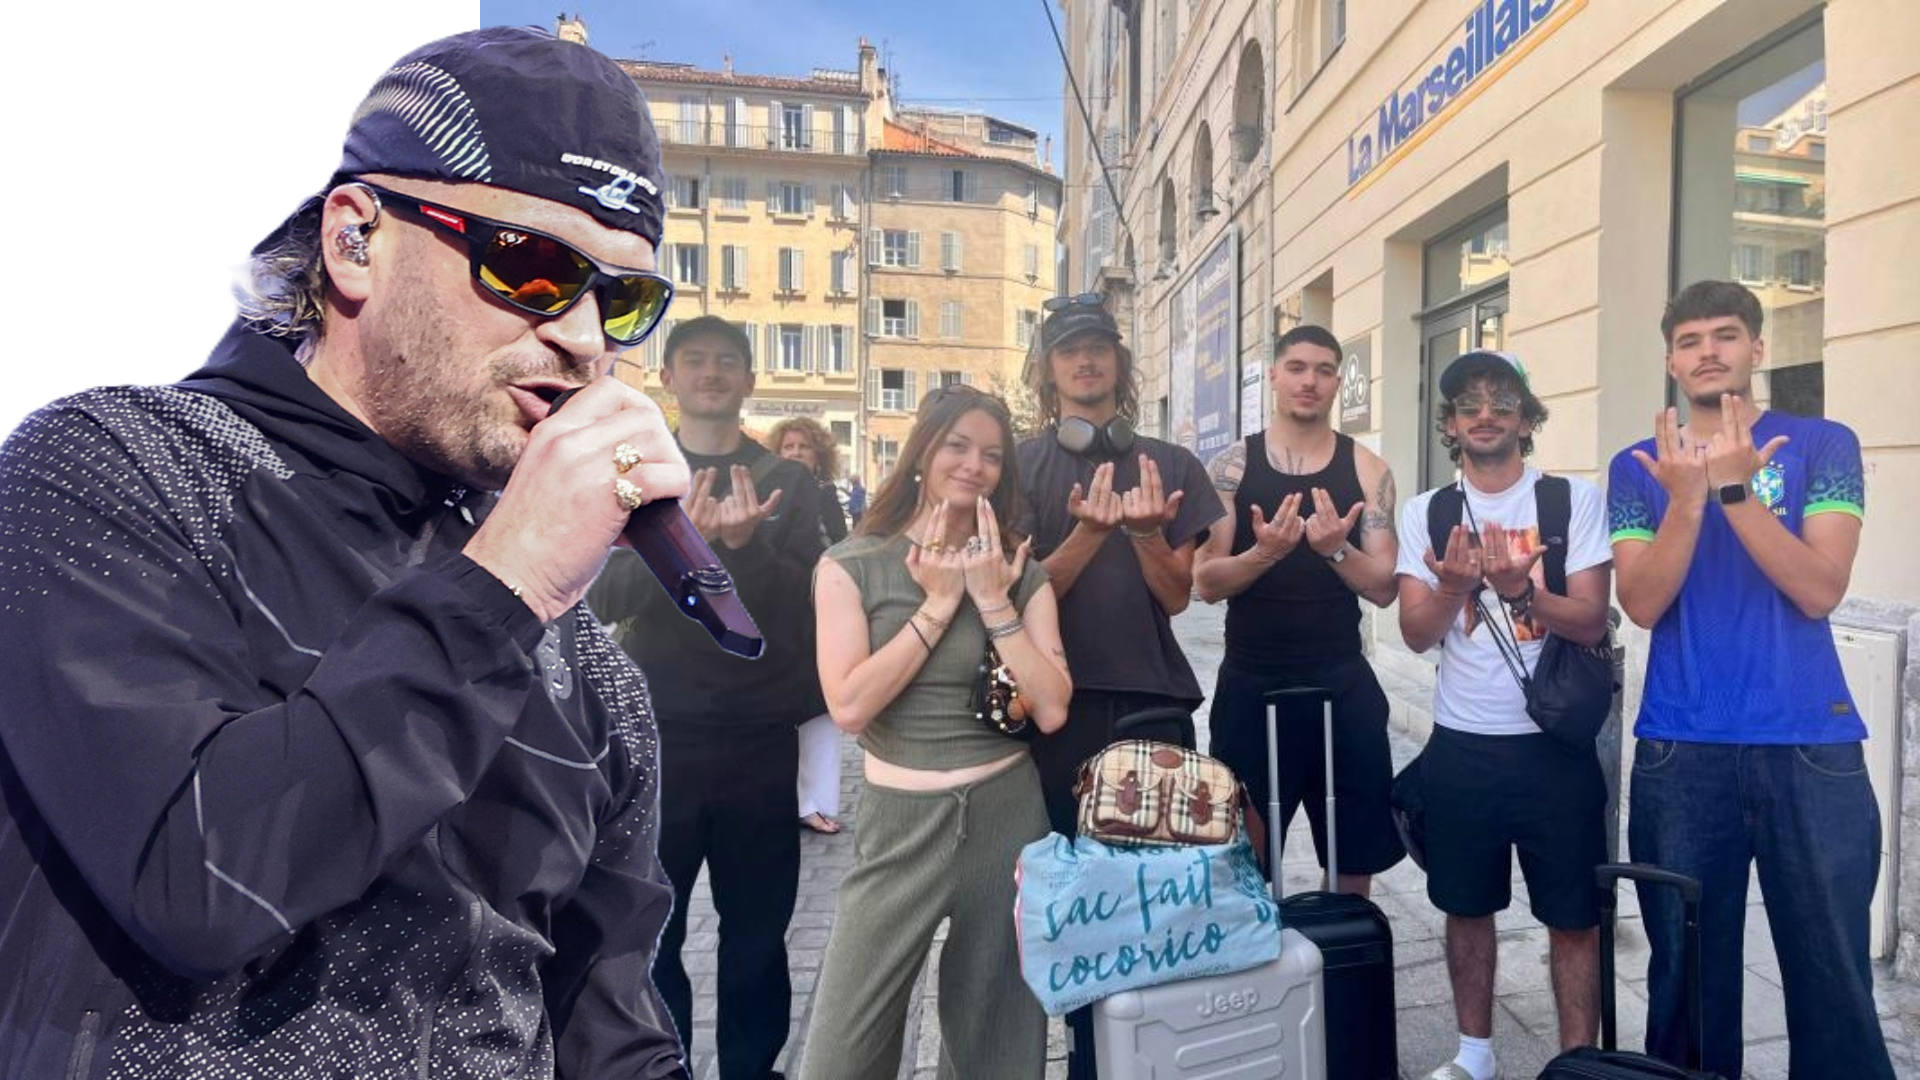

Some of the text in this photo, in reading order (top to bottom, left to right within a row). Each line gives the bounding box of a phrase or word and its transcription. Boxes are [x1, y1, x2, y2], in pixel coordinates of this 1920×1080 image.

[1347, 134, 1372, 186] La
[1042, 849, 1216, 942] sac fait
[1049, 921, 1230, 993] cocorico
[1197, 987, 1260, 1015] Jeep
